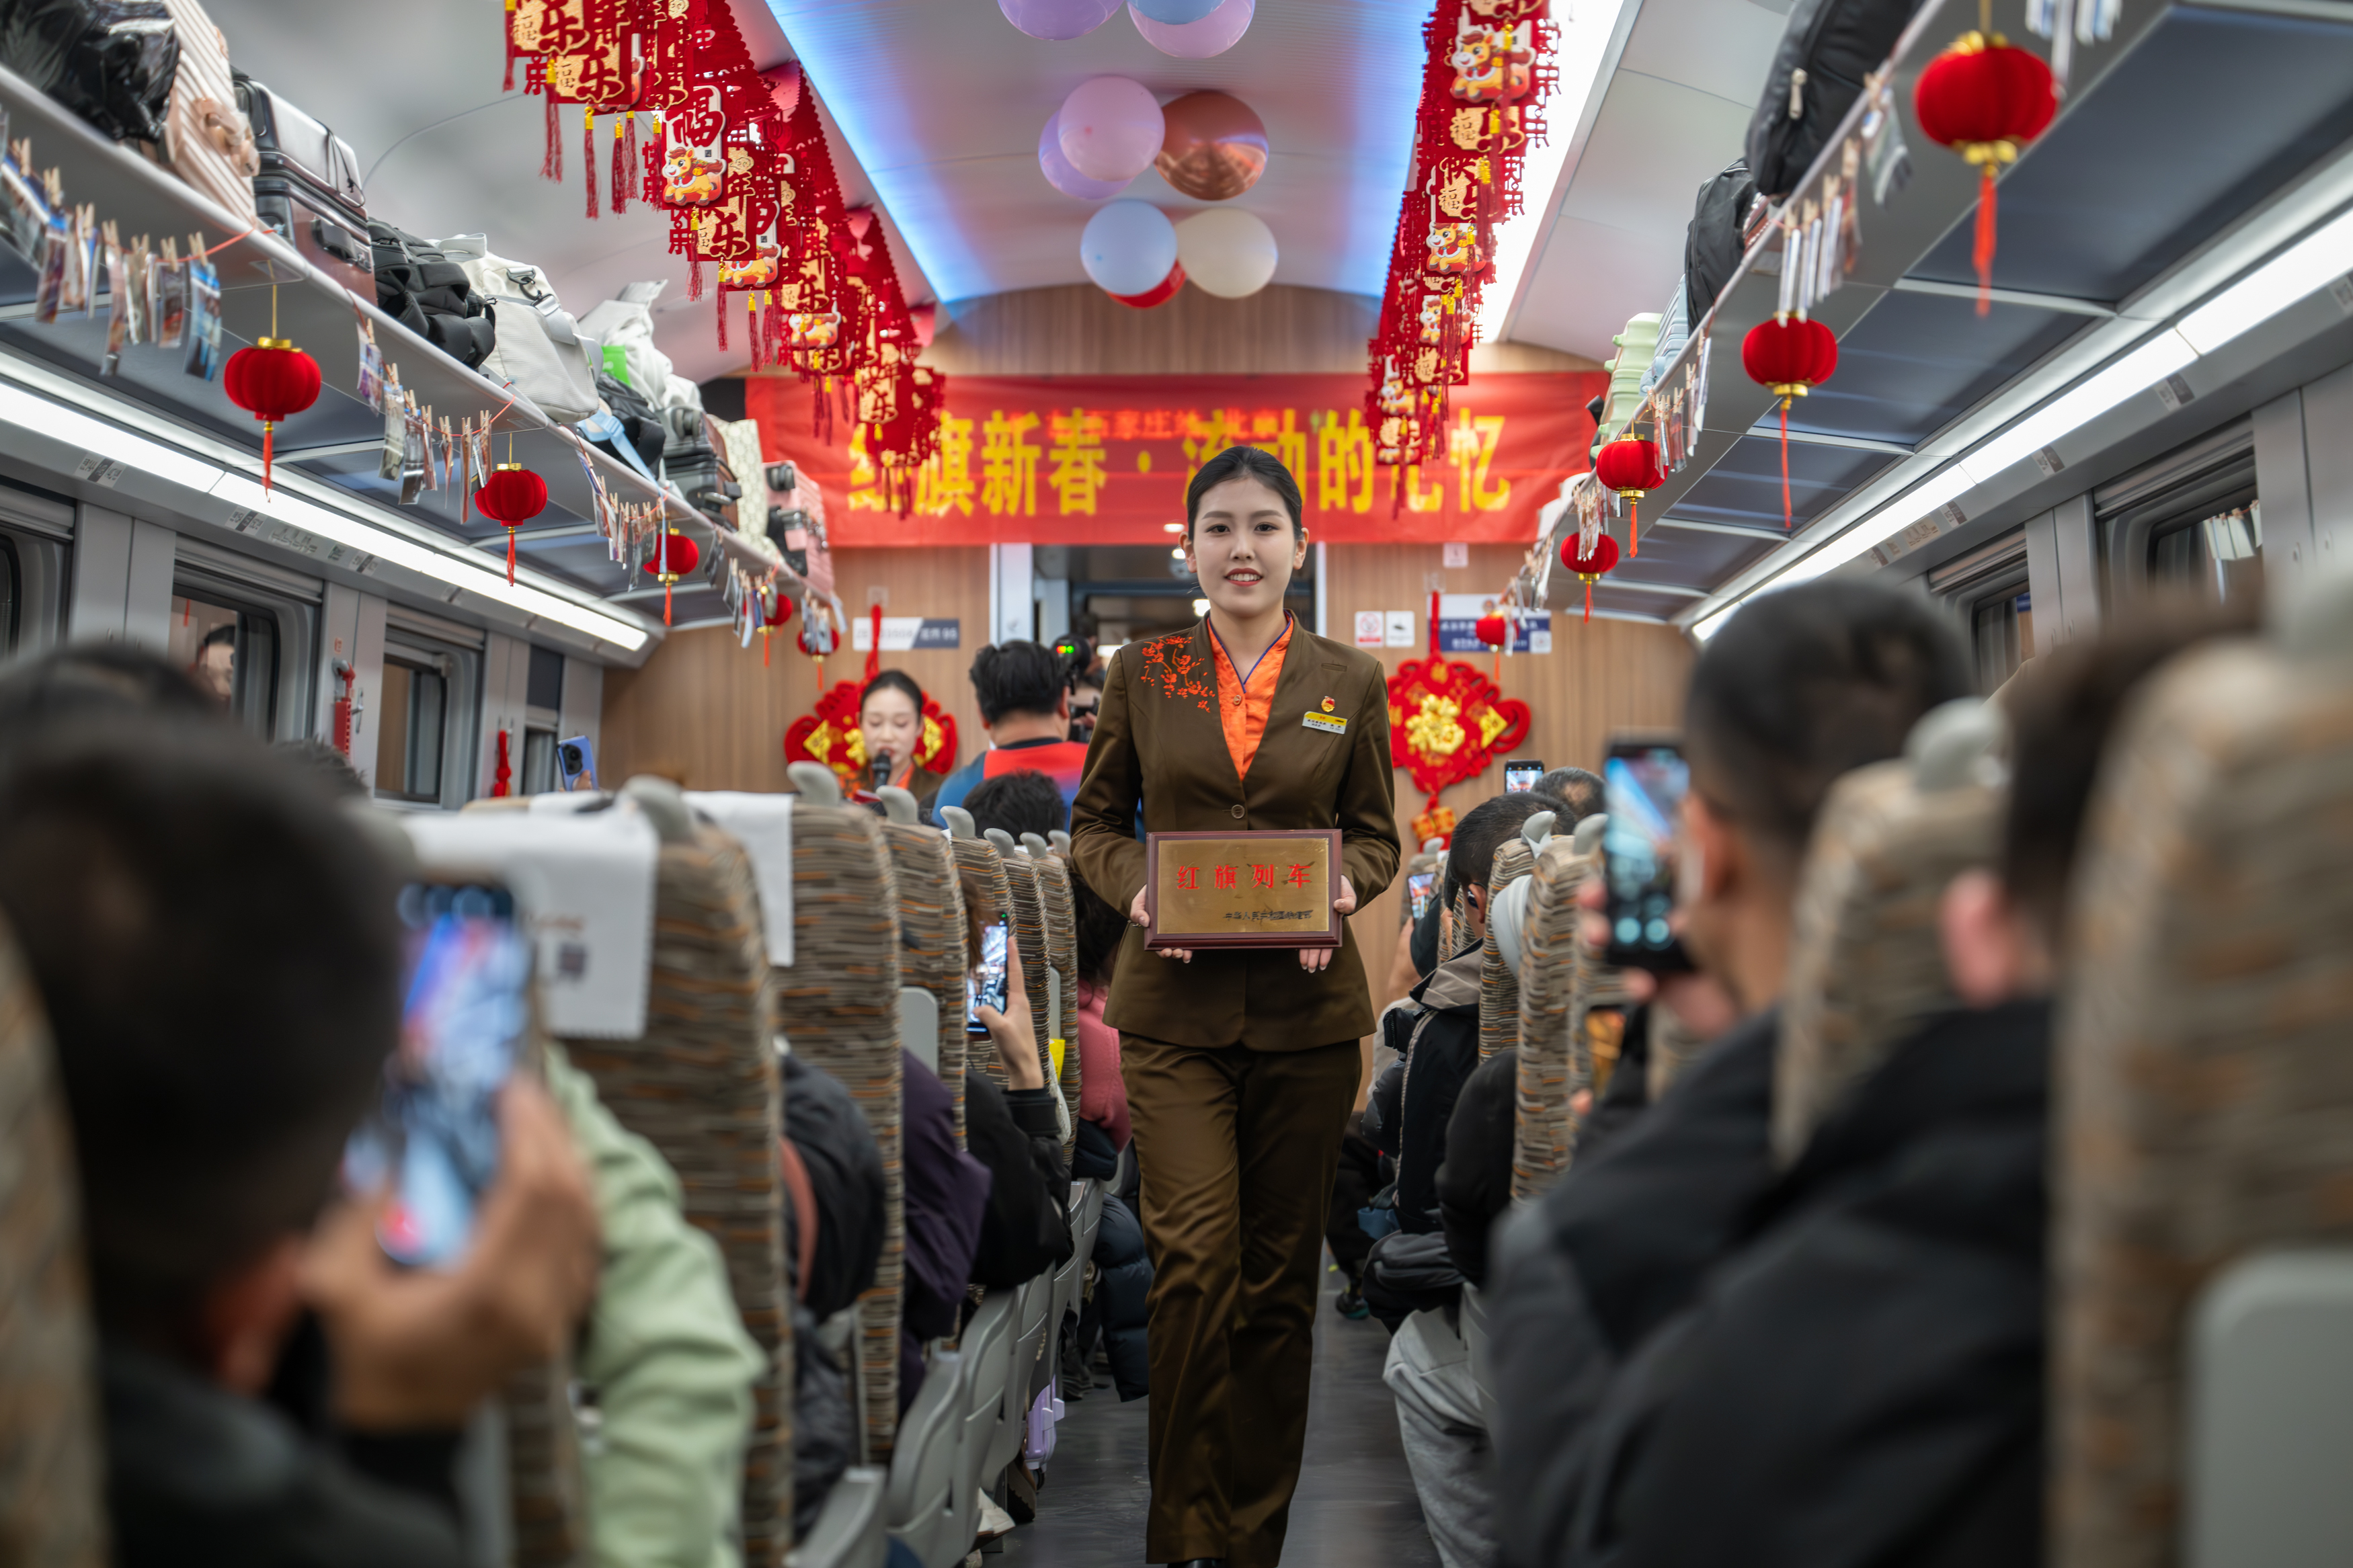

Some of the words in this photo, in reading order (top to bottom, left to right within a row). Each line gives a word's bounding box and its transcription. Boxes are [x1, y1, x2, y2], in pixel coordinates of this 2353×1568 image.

[848, 408, 1511, 518] 红旗新春·动的忆
[1176, 863, 1312, 890] 红旗列车
